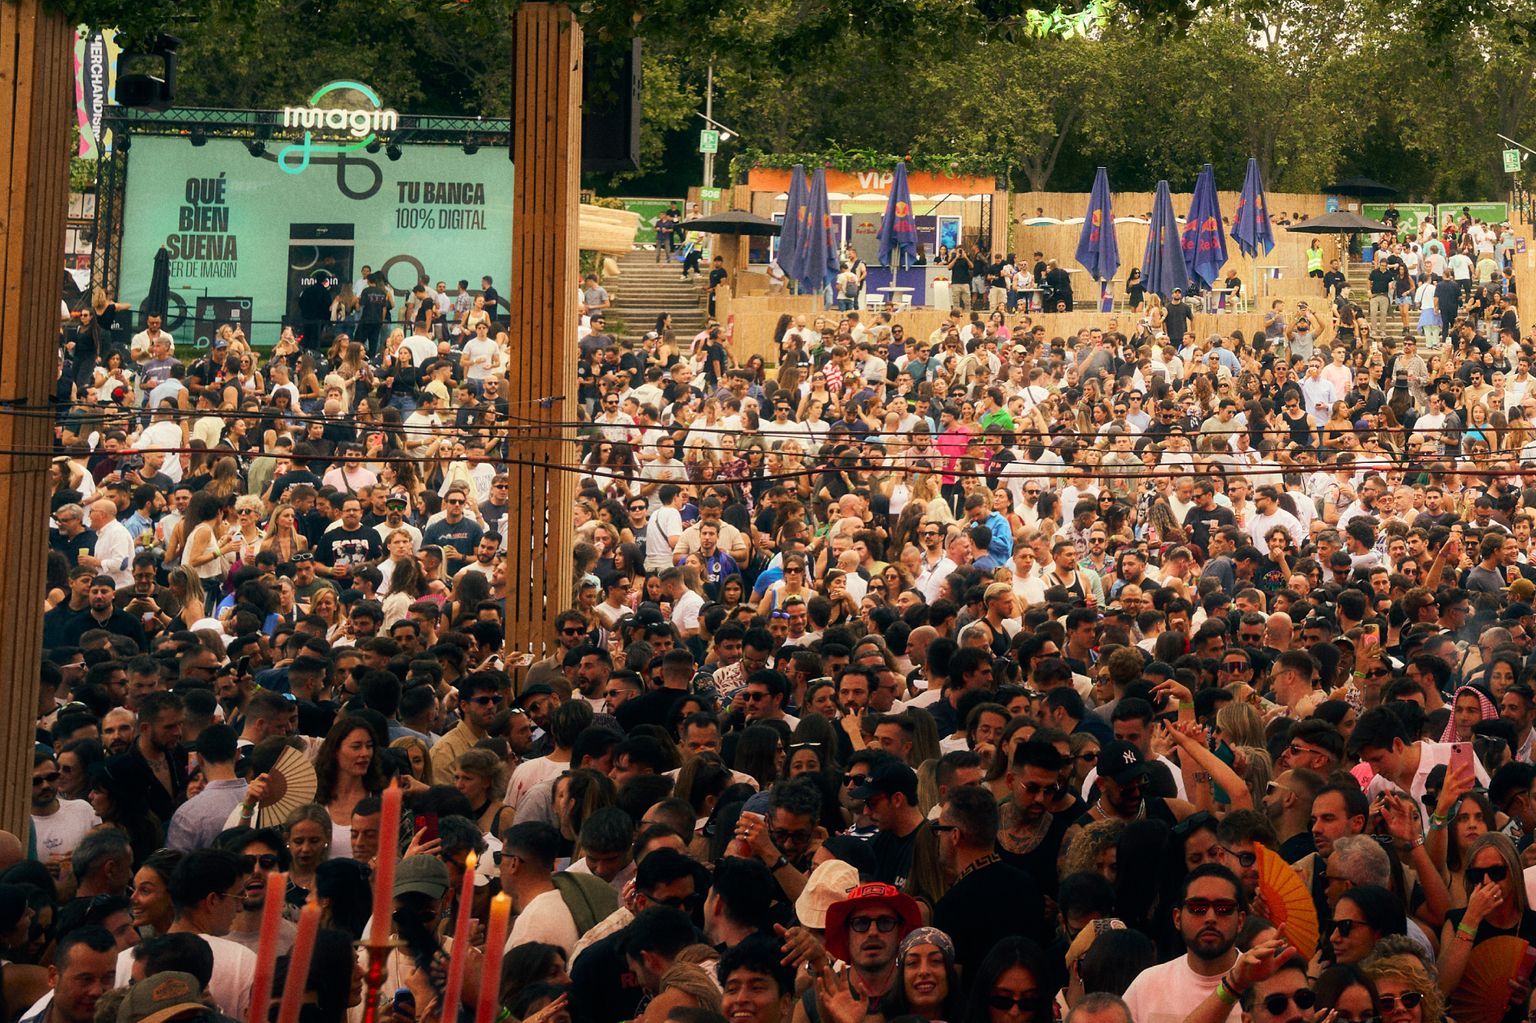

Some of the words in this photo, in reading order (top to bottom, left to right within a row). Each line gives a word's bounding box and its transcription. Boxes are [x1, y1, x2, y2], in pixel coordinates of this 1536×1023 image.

[283, 106, 398, 137] imagin
[185, 171, 227, 206] QUÉ
[858, 171, 894, 189] VIP
[397, 181, 421, 204] TU
[423, 181, 485, 205] BANCA
[701, 189, 720, 199] S06
[178, 205, 229, 233] BIEN
[396, 207, 436, 230] 100%
[438, 209, 487, 231] DIGITAL
[165, 233, 238, 261] SUENA
[185, 262, 199, 278] DE
[200, 262, 238, 278] IMAGIN
